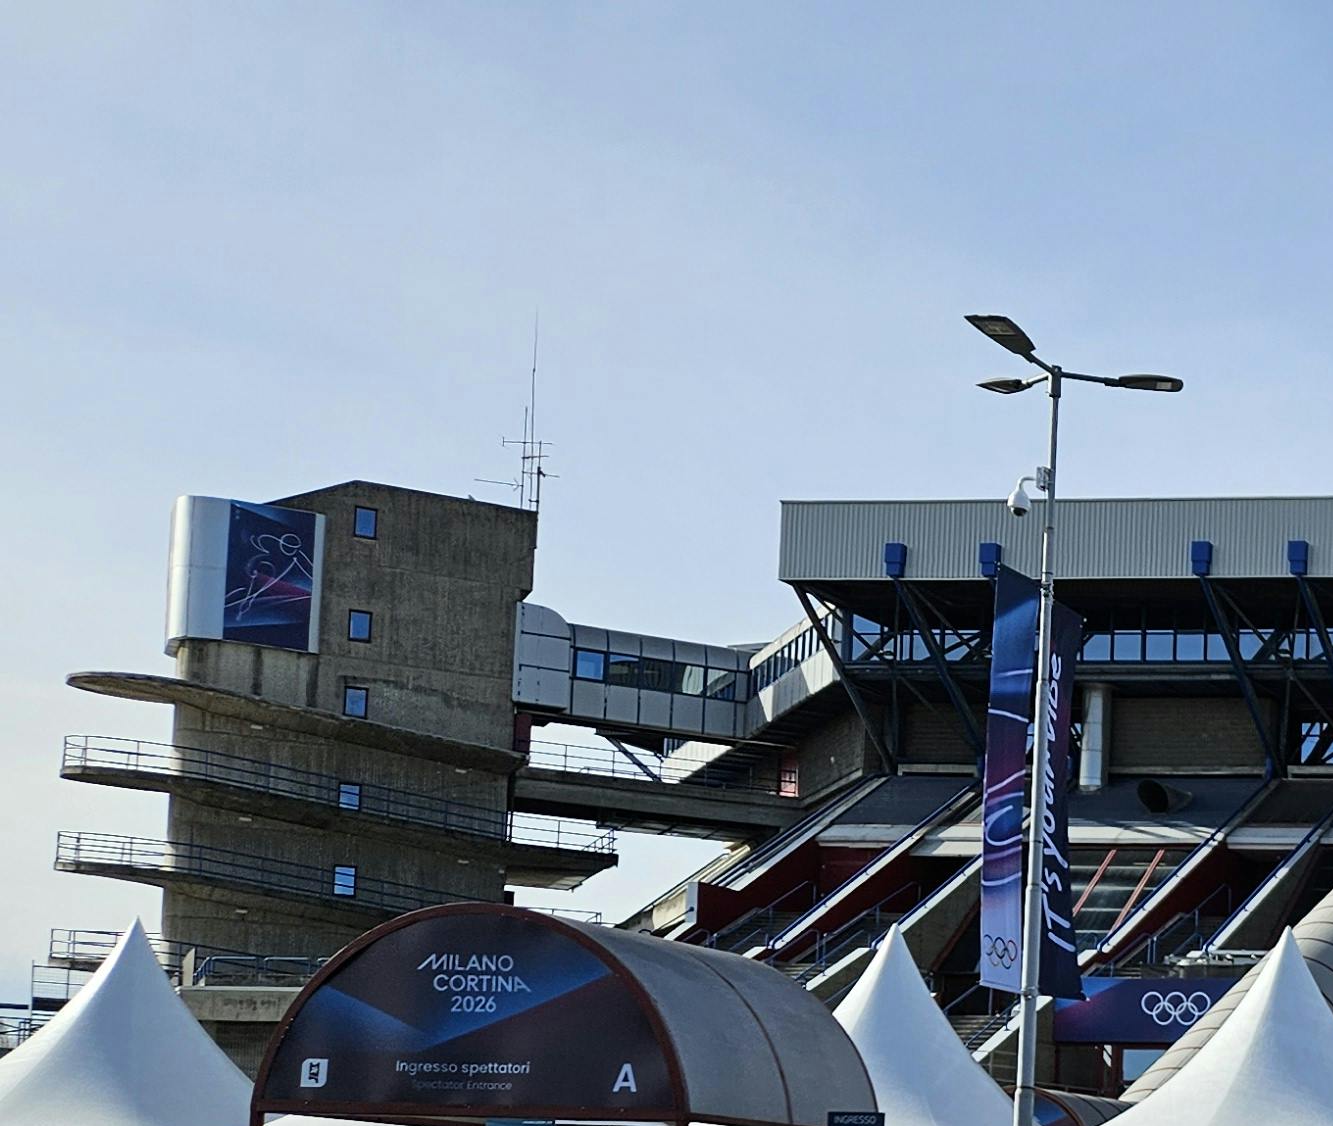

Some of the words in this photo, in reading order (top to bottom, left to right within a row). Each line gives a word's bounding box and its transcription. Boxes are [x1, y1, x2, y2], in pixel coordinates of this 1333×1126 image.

[417, 953, 514, 972] MILANO
[433, 974, 531, 992] CORTINA
[450, 995, 497, 1013] 2026
[395, 1060, 458, 1076] Ingresso
[461, 1061, 531, 1077] spettatori
[612, 1062, 637, 1093] A
[833, 1115, 877, 1125] INGRESSO
